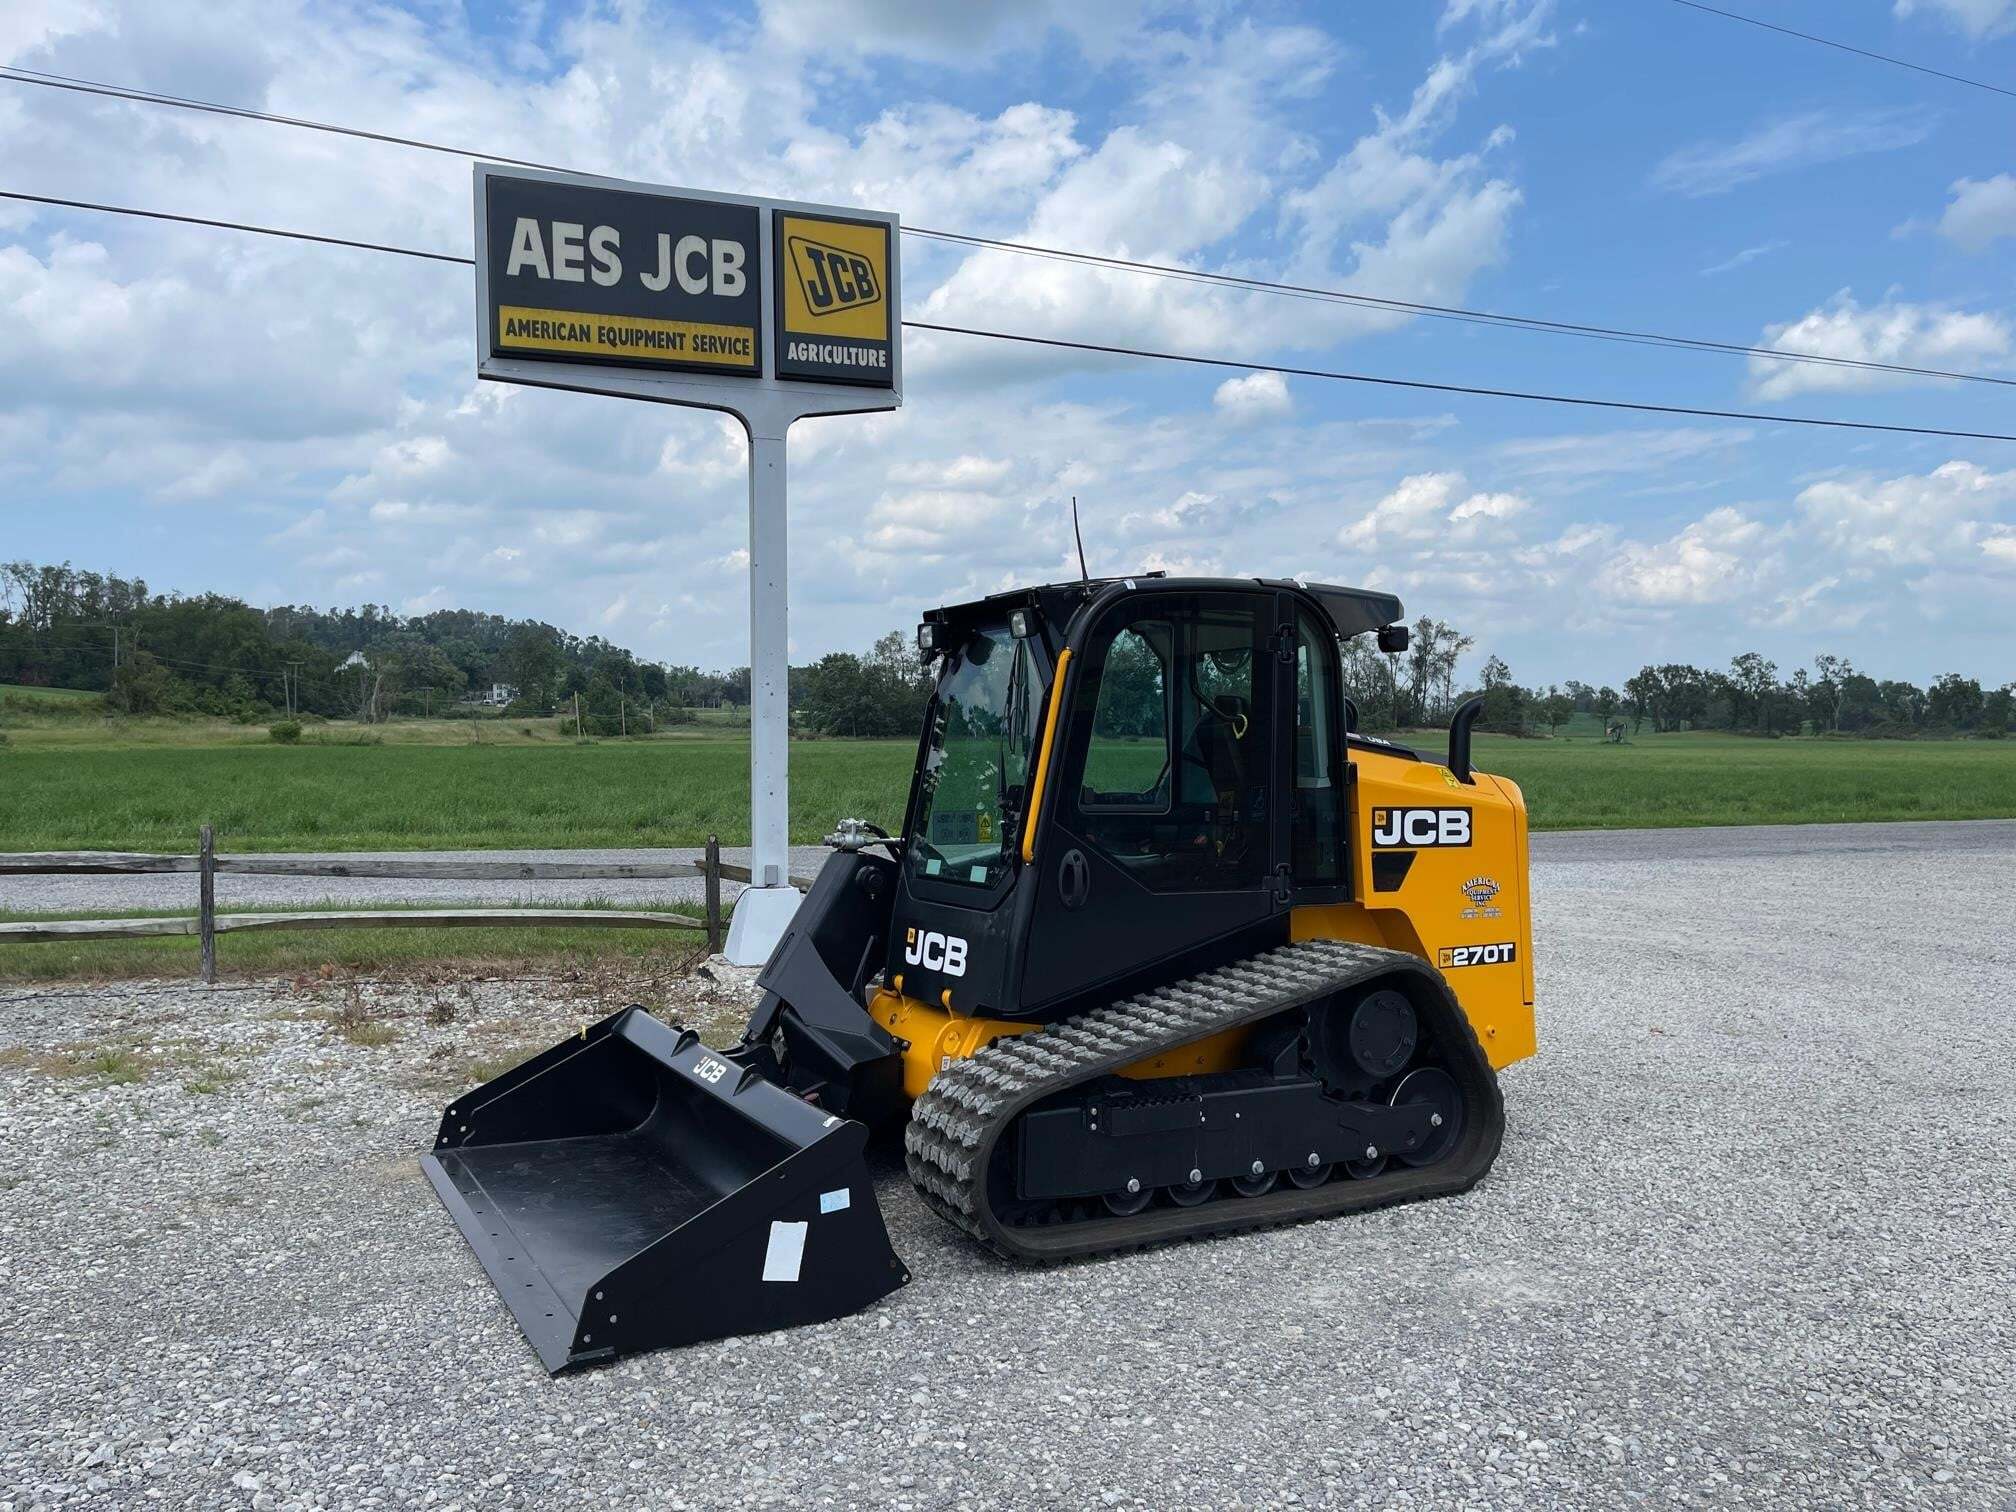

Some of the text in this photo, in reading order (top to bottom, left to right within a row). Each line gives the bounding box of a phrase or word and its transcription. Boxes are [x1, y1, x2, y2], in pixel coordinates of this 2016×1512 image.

[506, 216, 747, 297] AES JCB
[805, 246, 875, 308] JCB
[505, 317, 750, 356] AMERICAN EQUIPMENT SERVICE
[787, 341, 887, 368] AGRICULTURE
[1374, 810, 1470, 845] JCB
[1461, 876, 1501, 893] AMERICAN
[905, 929, 968, 977] JCB
[1453, 943, 1514, 966] 270T
[693, 1057, 727, 1084] JCB
